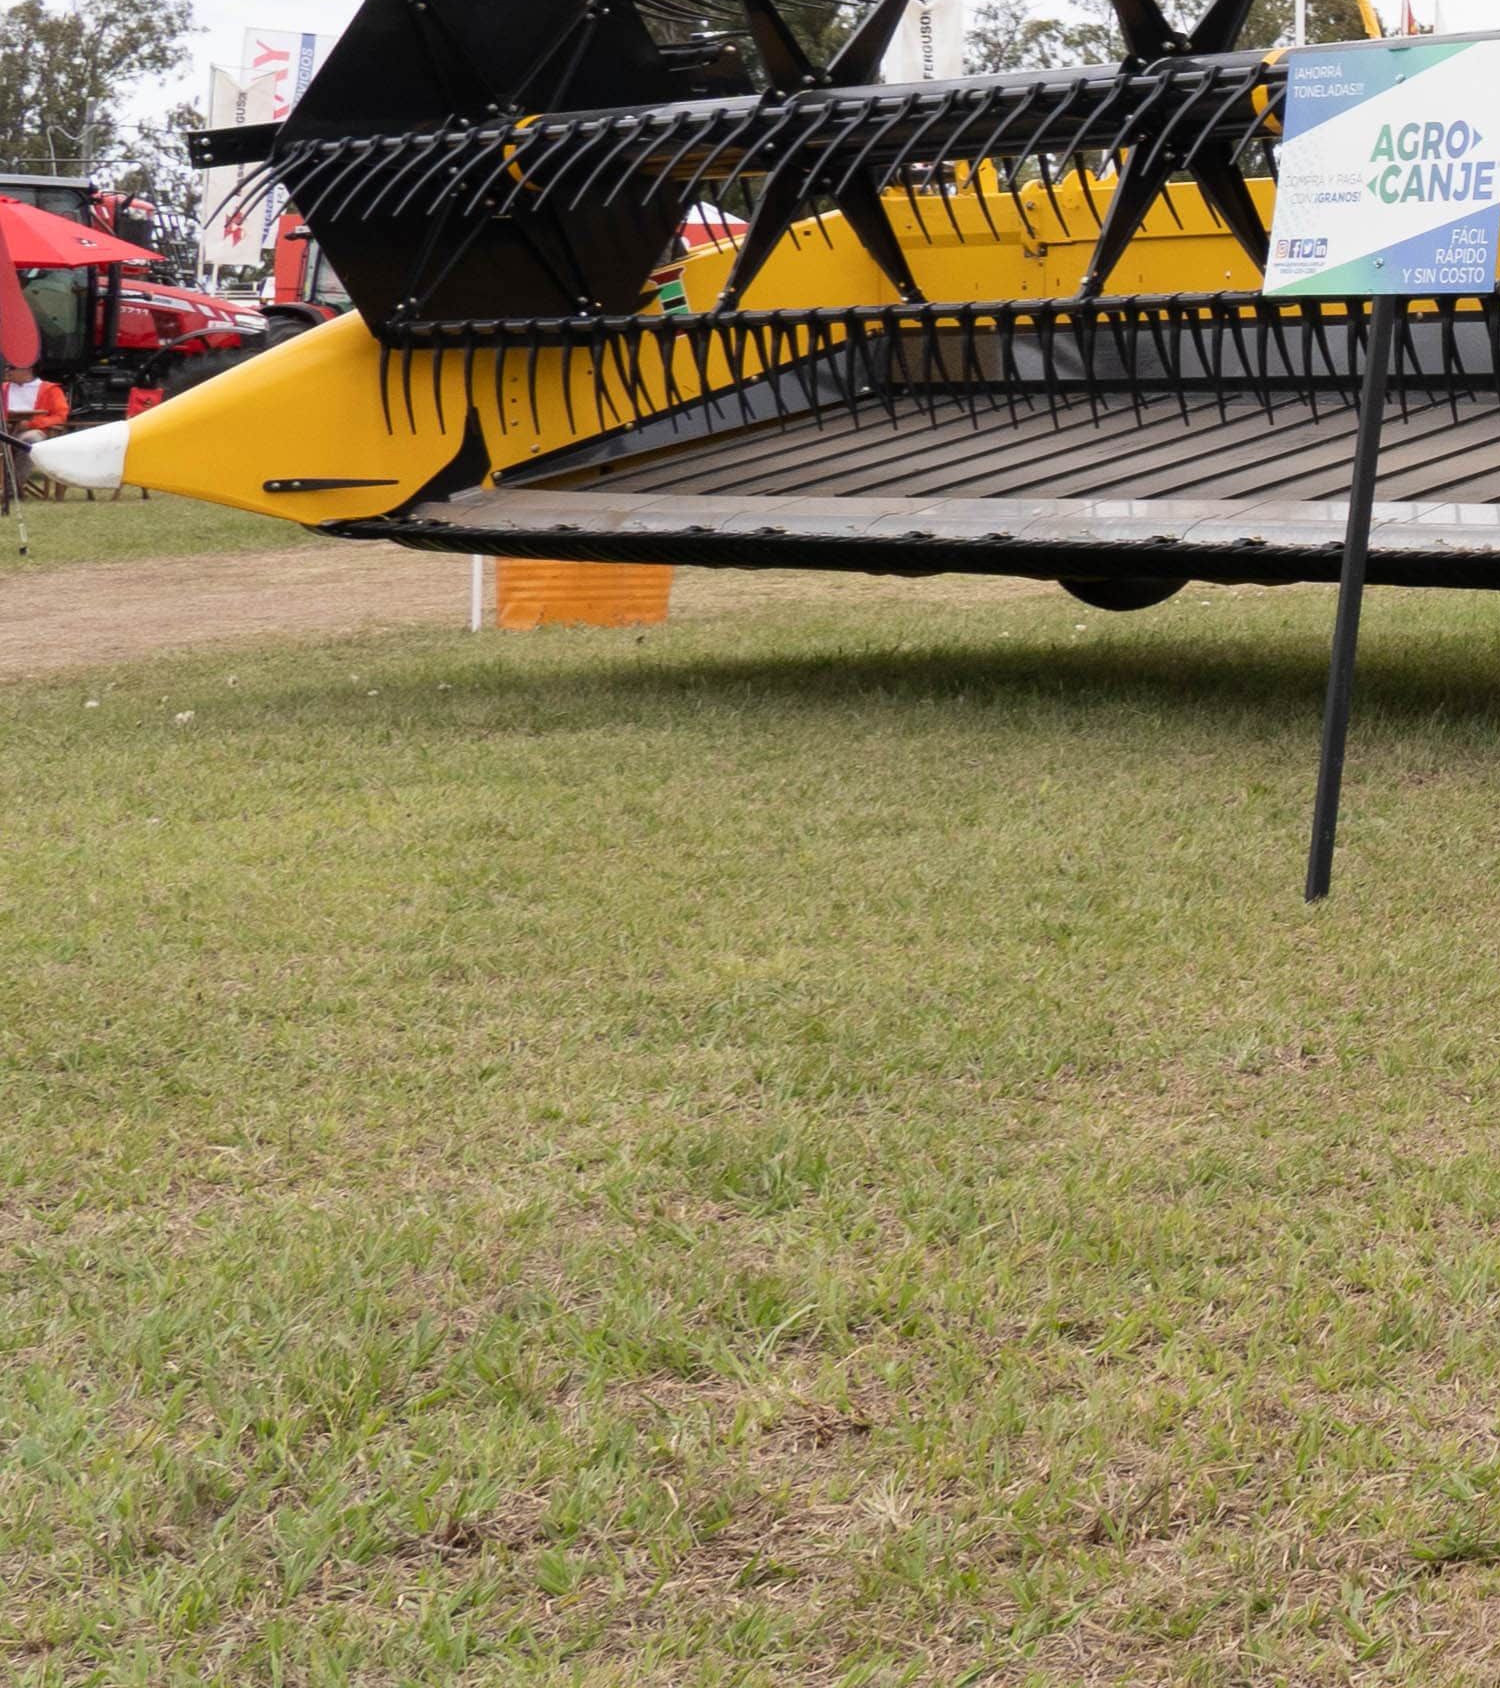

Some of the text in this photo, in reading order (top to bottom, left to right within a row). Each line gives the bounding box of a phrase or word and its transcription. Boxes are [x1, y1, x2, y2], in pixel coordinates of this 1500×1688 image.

[1370, 120, 1470, 163] AGRO
[1379, 161, 1496, 204] CANJE
[1451, 225, 1488, 245] FÁCIL
[1435, 245, 1487, 265] RÁPIDO
[1402, 267, 1485, 284] Y SIN COSTO
